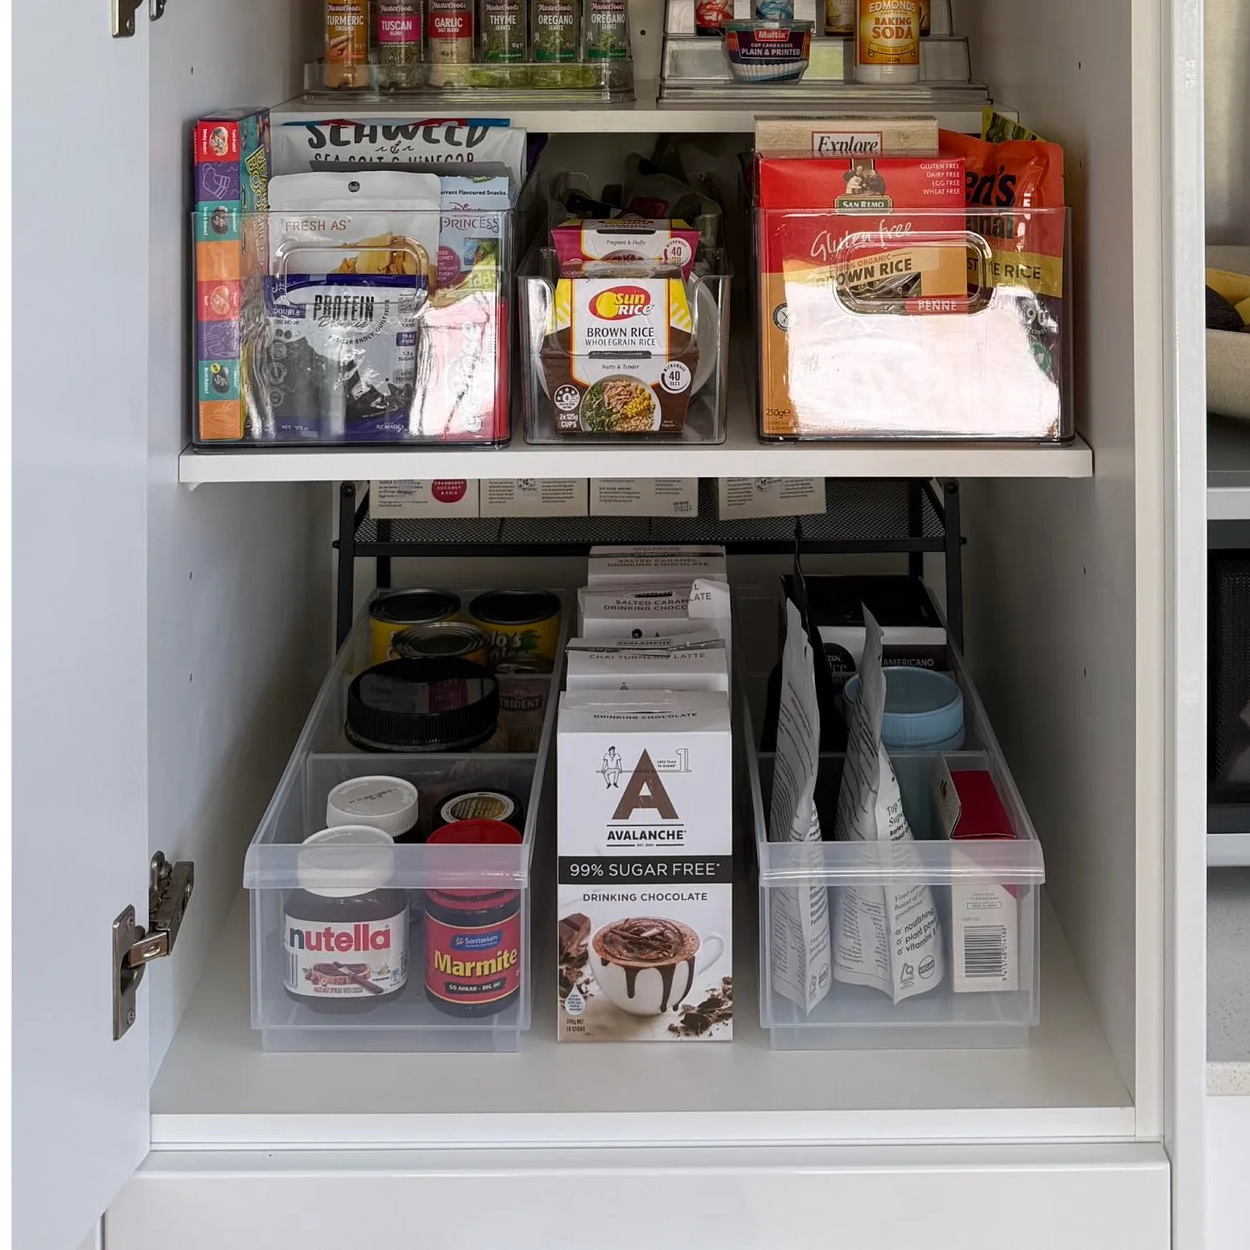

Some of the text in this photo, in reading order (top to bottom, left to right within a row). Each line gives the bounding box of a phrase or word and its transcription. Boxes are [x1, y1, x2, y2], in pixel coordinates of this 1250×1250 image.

[327, 3, 361, 13] MasterFoods
[380, 4, 414, 13] MasterFoods
[431, 1, 466, 10] MasterFoods
[485, 3, 520, 12] MasterFoods
[538, 3, 573, 12] MasterFoods
[869, 1, 916, 14] EDMONDS
[327, 15, 364, 25] TURMERIC
[434, 18, 463, 28] GARLIC
[490, 15, 517, 25] THYME
[538, 15, 574, 25] OREGANO
[591, 13, 625, 24] OREGANO
[874, 17, 912, 25] BAKING
[382, 21, 412, 31] TUSCAN
[758, 30, 786, 39] Multix
[872, 26, 913, 39] SODA
[741, 48, 762, 56] PLAIN
[771, 48, 801, 56] PRINTED
[307, 126, 491, 149] SEAWEED
[816, 135, 879, 153] Explore
[842, 201, 885, 209] SAN REMO
[285, 219, 347, 232] FRESH AS
[439, 216, 500, 233] PRINCESS
[810, 220, 915, 261] Gluten free
[671, 247, 682, 257] 40
[857, 253, 892, 268] ORGANIC
[879, 258, 912, 277] RICE
[1004, 264, 1041, 280] RICE
[614, 292, 646, 306] Sun
[313, 295, 374, 321] PROTEIN
[618, 305, 651, 316] RICE
[917, 301, 958, 312] PENNE
[1026, 307, 1047, 325] 90
[587, 327, 655, 339] BROWN RICE
[584, 338, 655, 347] WHOLEGRAIN RICE
[669, 370, 681, 381] 40
[766, 408, 784, 418] 250g
[560, 420, 577, 429] CUPS
[883, 658, 934, 667] AMERICANO
[500, 699, 540, 709] TRIDENT
[607, 830, 684, 841] AVALANCHE
[570, 863, 667, 877] 99% SUGAR
[582, 892, 708, 902] DRINKING CHOCOLATE
[904, 908, 935, 933] nourishing
[289, 924, 391, 953] nutella
[905, 926, 924, 944] plant
[905, 933, 933, 953] vitamins
[434, 948, 518, 978] Marmite
[456, 984, 477, 992] AHEAD
